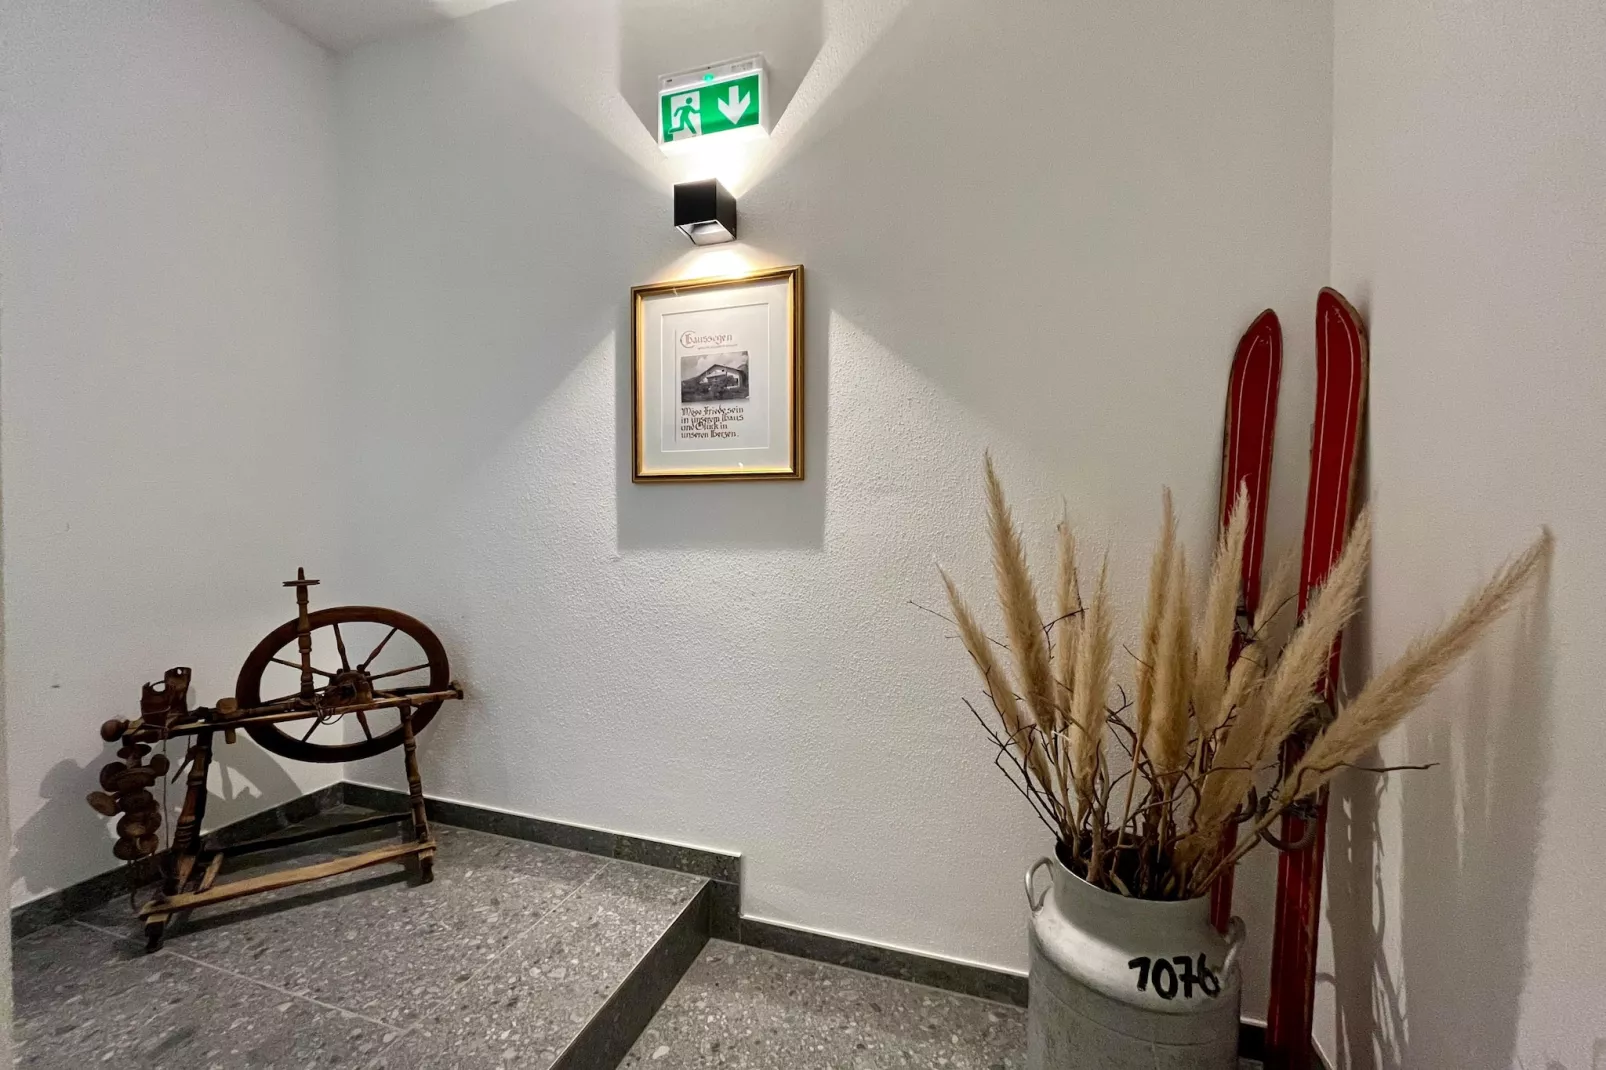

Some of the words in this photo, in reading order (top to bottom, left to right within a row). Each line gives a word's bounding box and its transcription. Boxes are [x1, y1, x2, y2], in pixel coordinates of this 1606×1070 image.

[727, 405, 744, 414] sein
[681, 416, 689, 424] in
[720, 421, 728, 430] in
